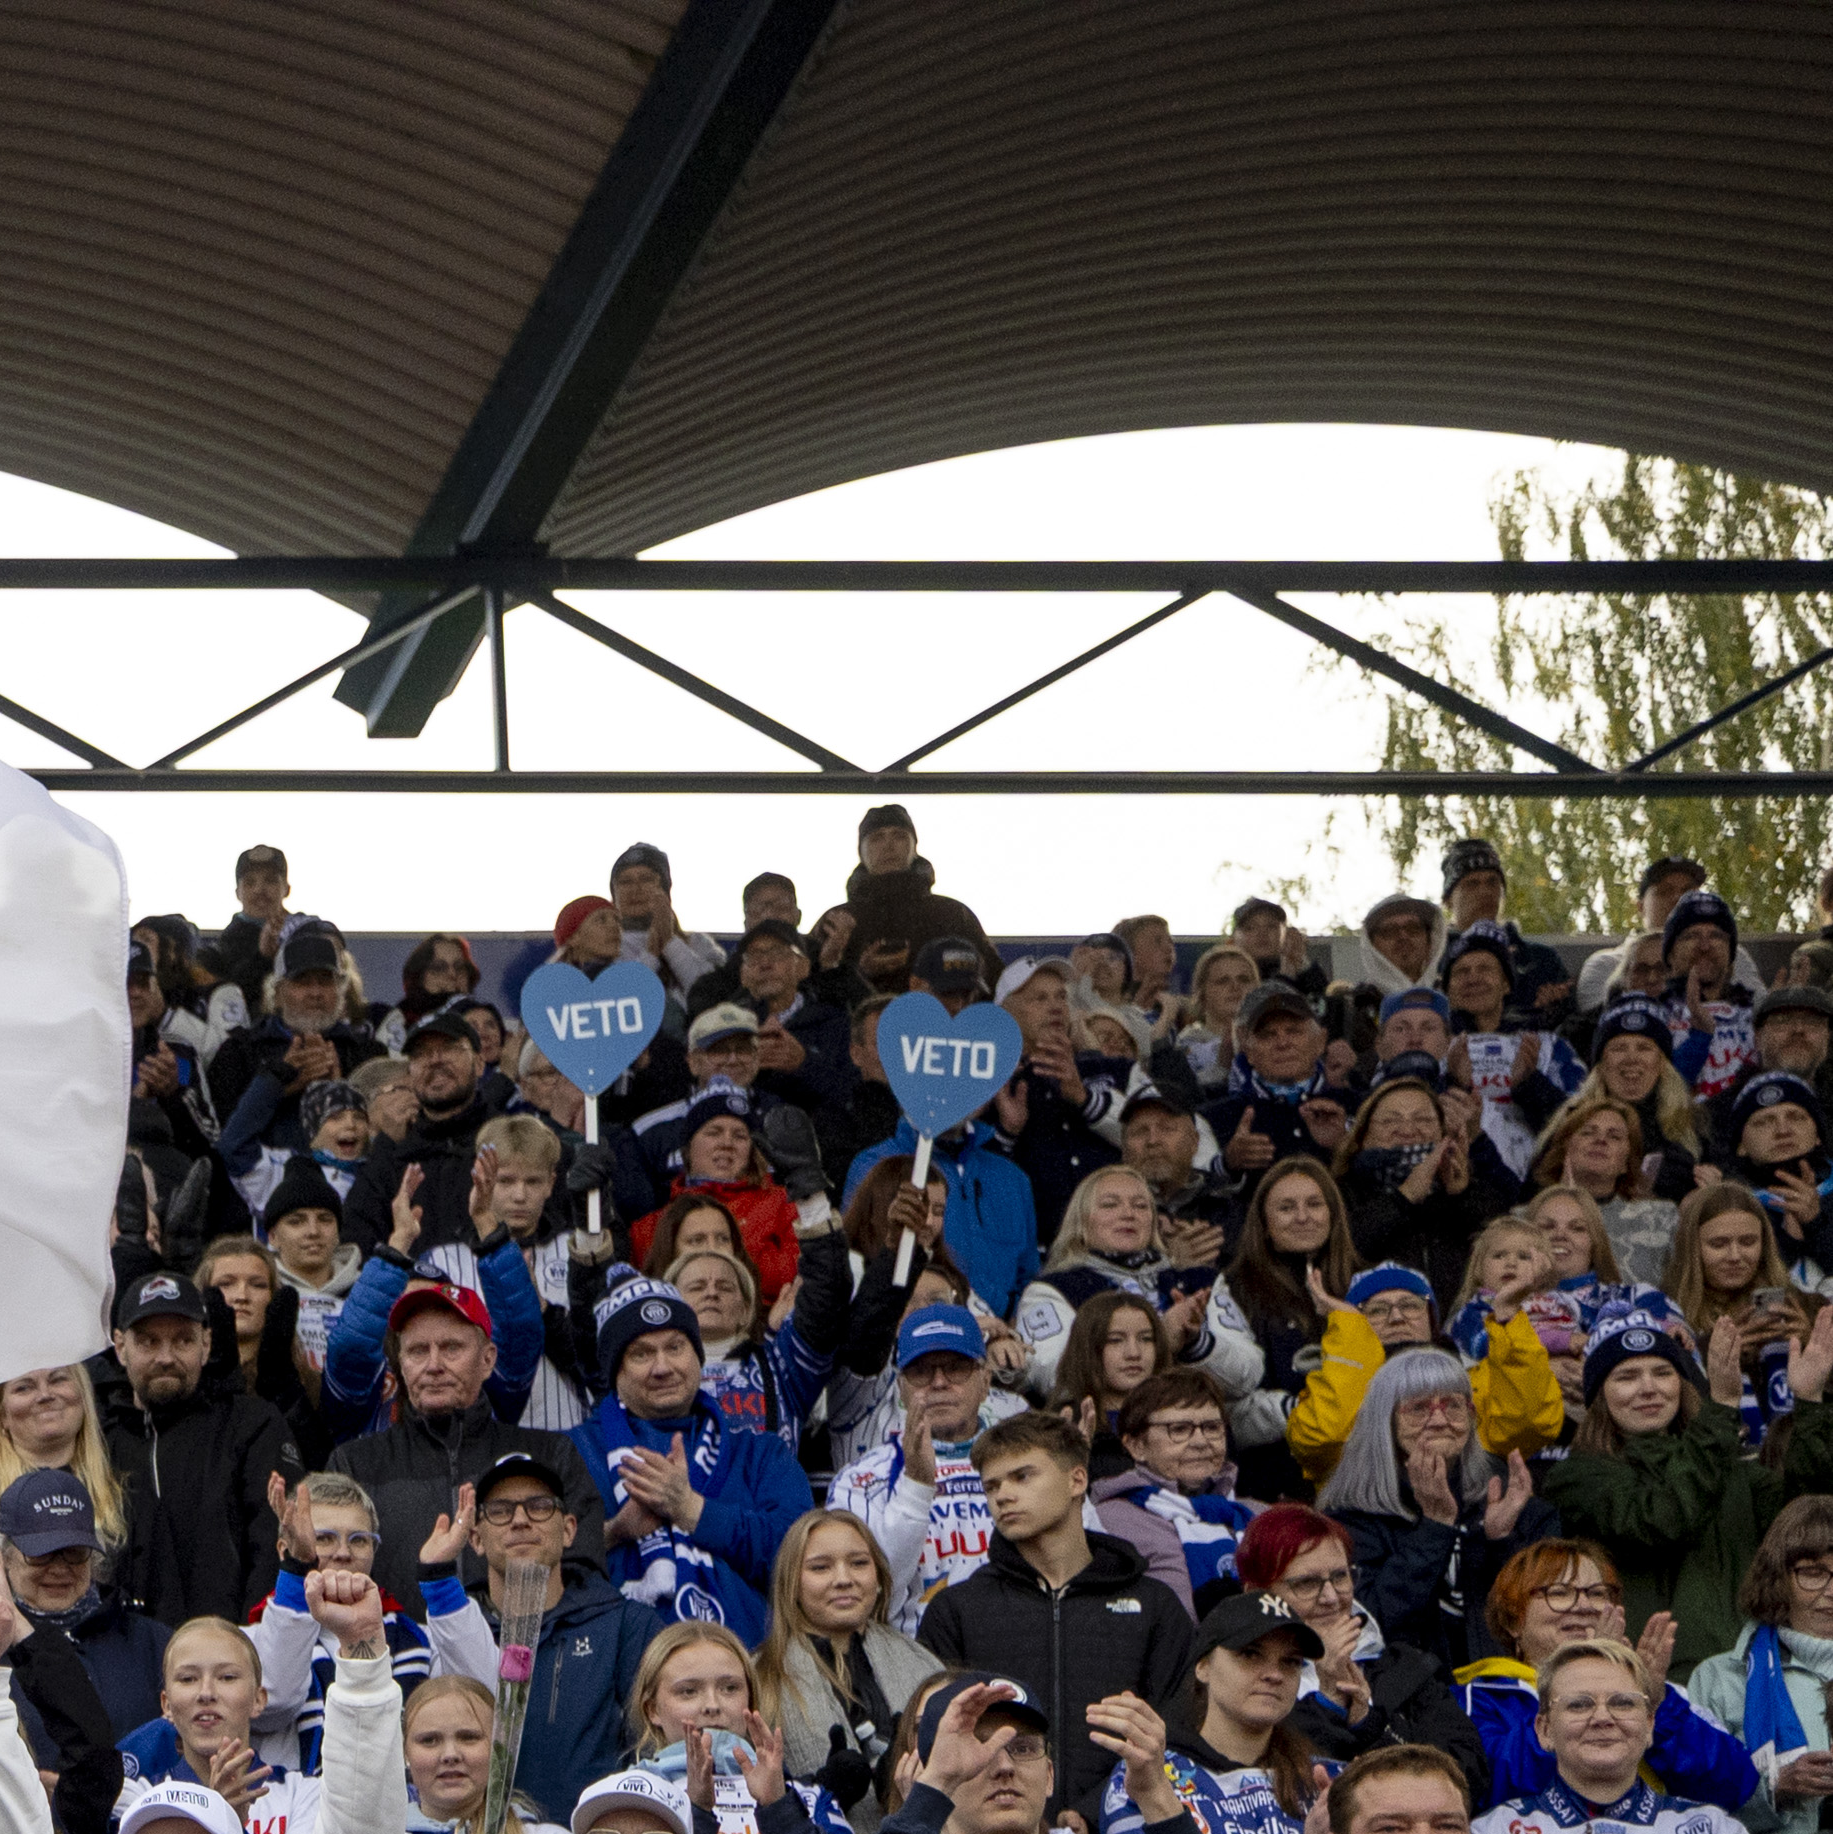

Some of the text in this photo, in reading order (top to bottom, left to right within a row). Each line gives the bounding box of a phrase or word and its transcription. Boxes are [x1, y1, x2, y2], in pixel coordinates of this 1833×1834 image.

[546, 997, 645, 1042] VETO
[900, 1034, 997, 1080] VETO
[33, 1494, 85, 1513] SUNDAY
[1259, 1593, 1291, 1618] NY
